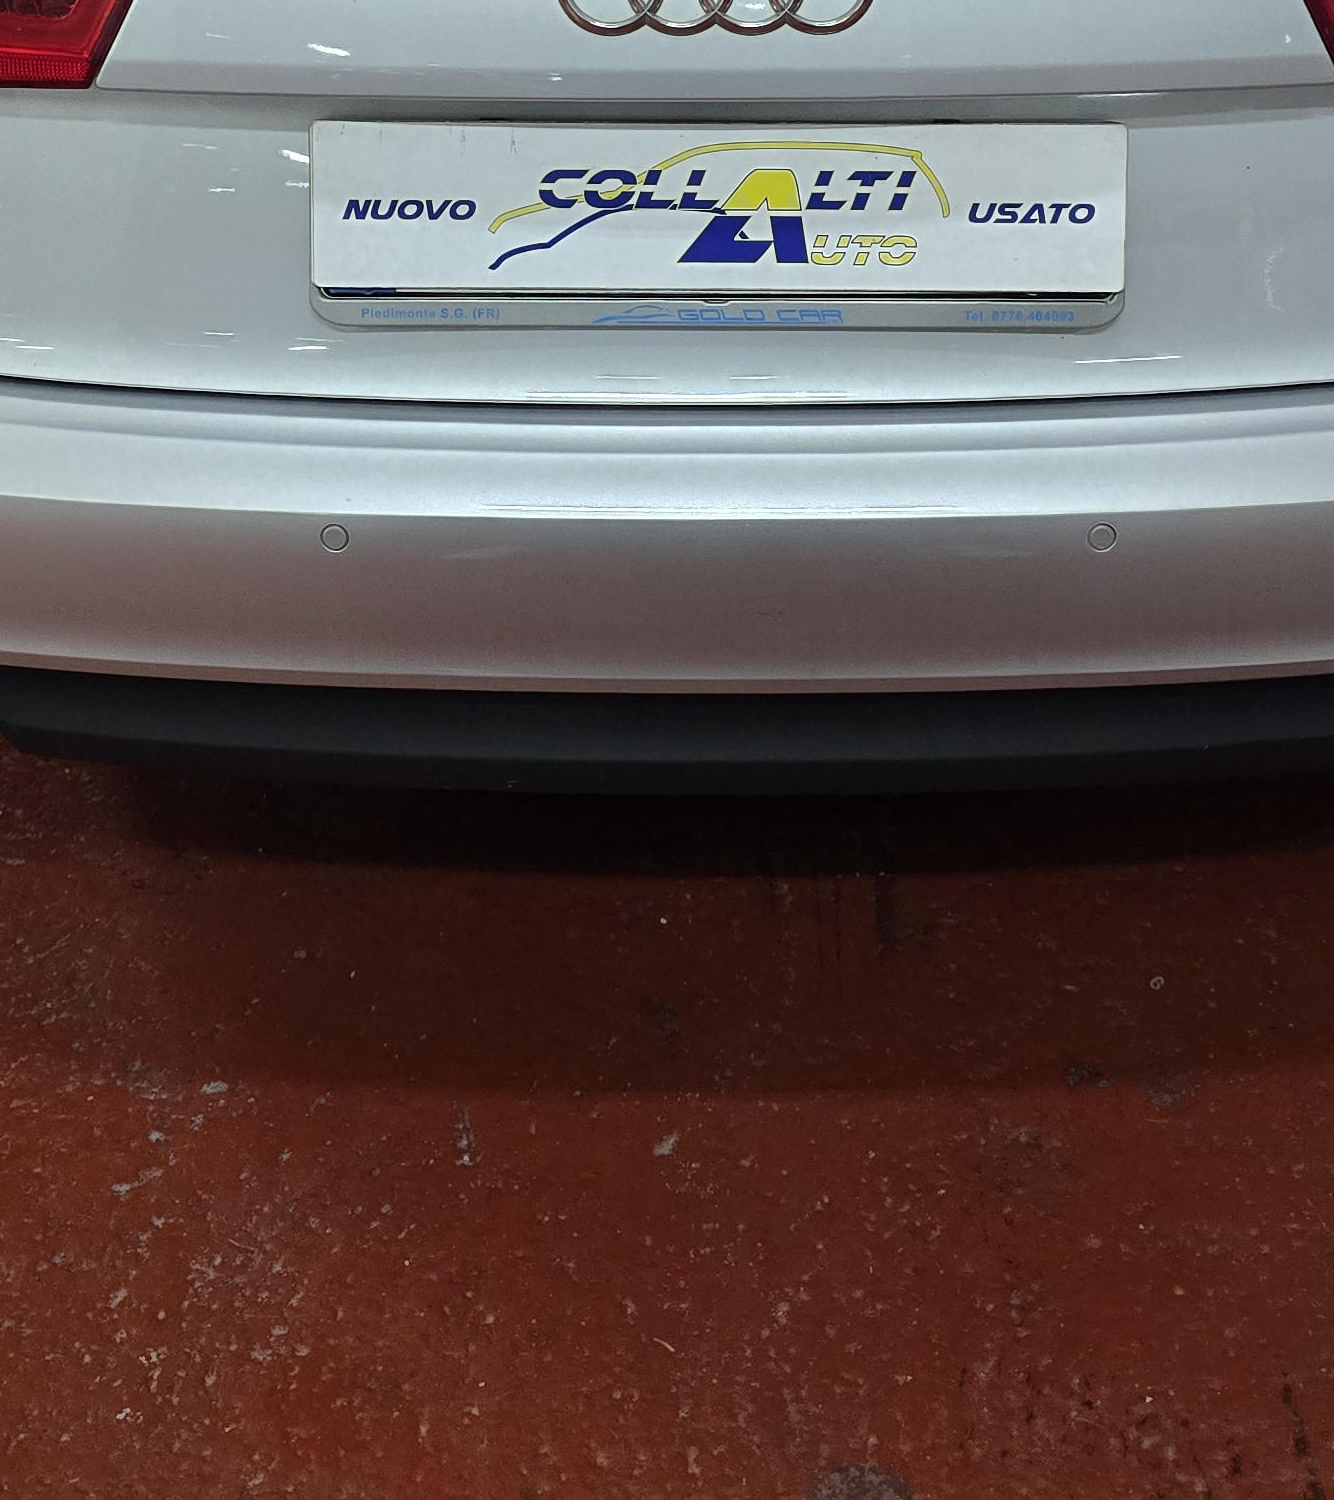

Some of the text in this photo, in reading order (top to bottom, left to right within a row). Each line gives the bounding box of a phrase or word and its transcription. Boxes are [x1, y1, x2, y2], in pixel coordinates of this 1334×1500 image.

[342, 199, 477, 220] NUOVO
[968, 203, 1096, 224] USATO
[361, 308, 500, 320] Piedimonte S.G. (FR)
[677, 308, 844, 324] GOLD CAR
[964, 311, 987, 321] Tel.
